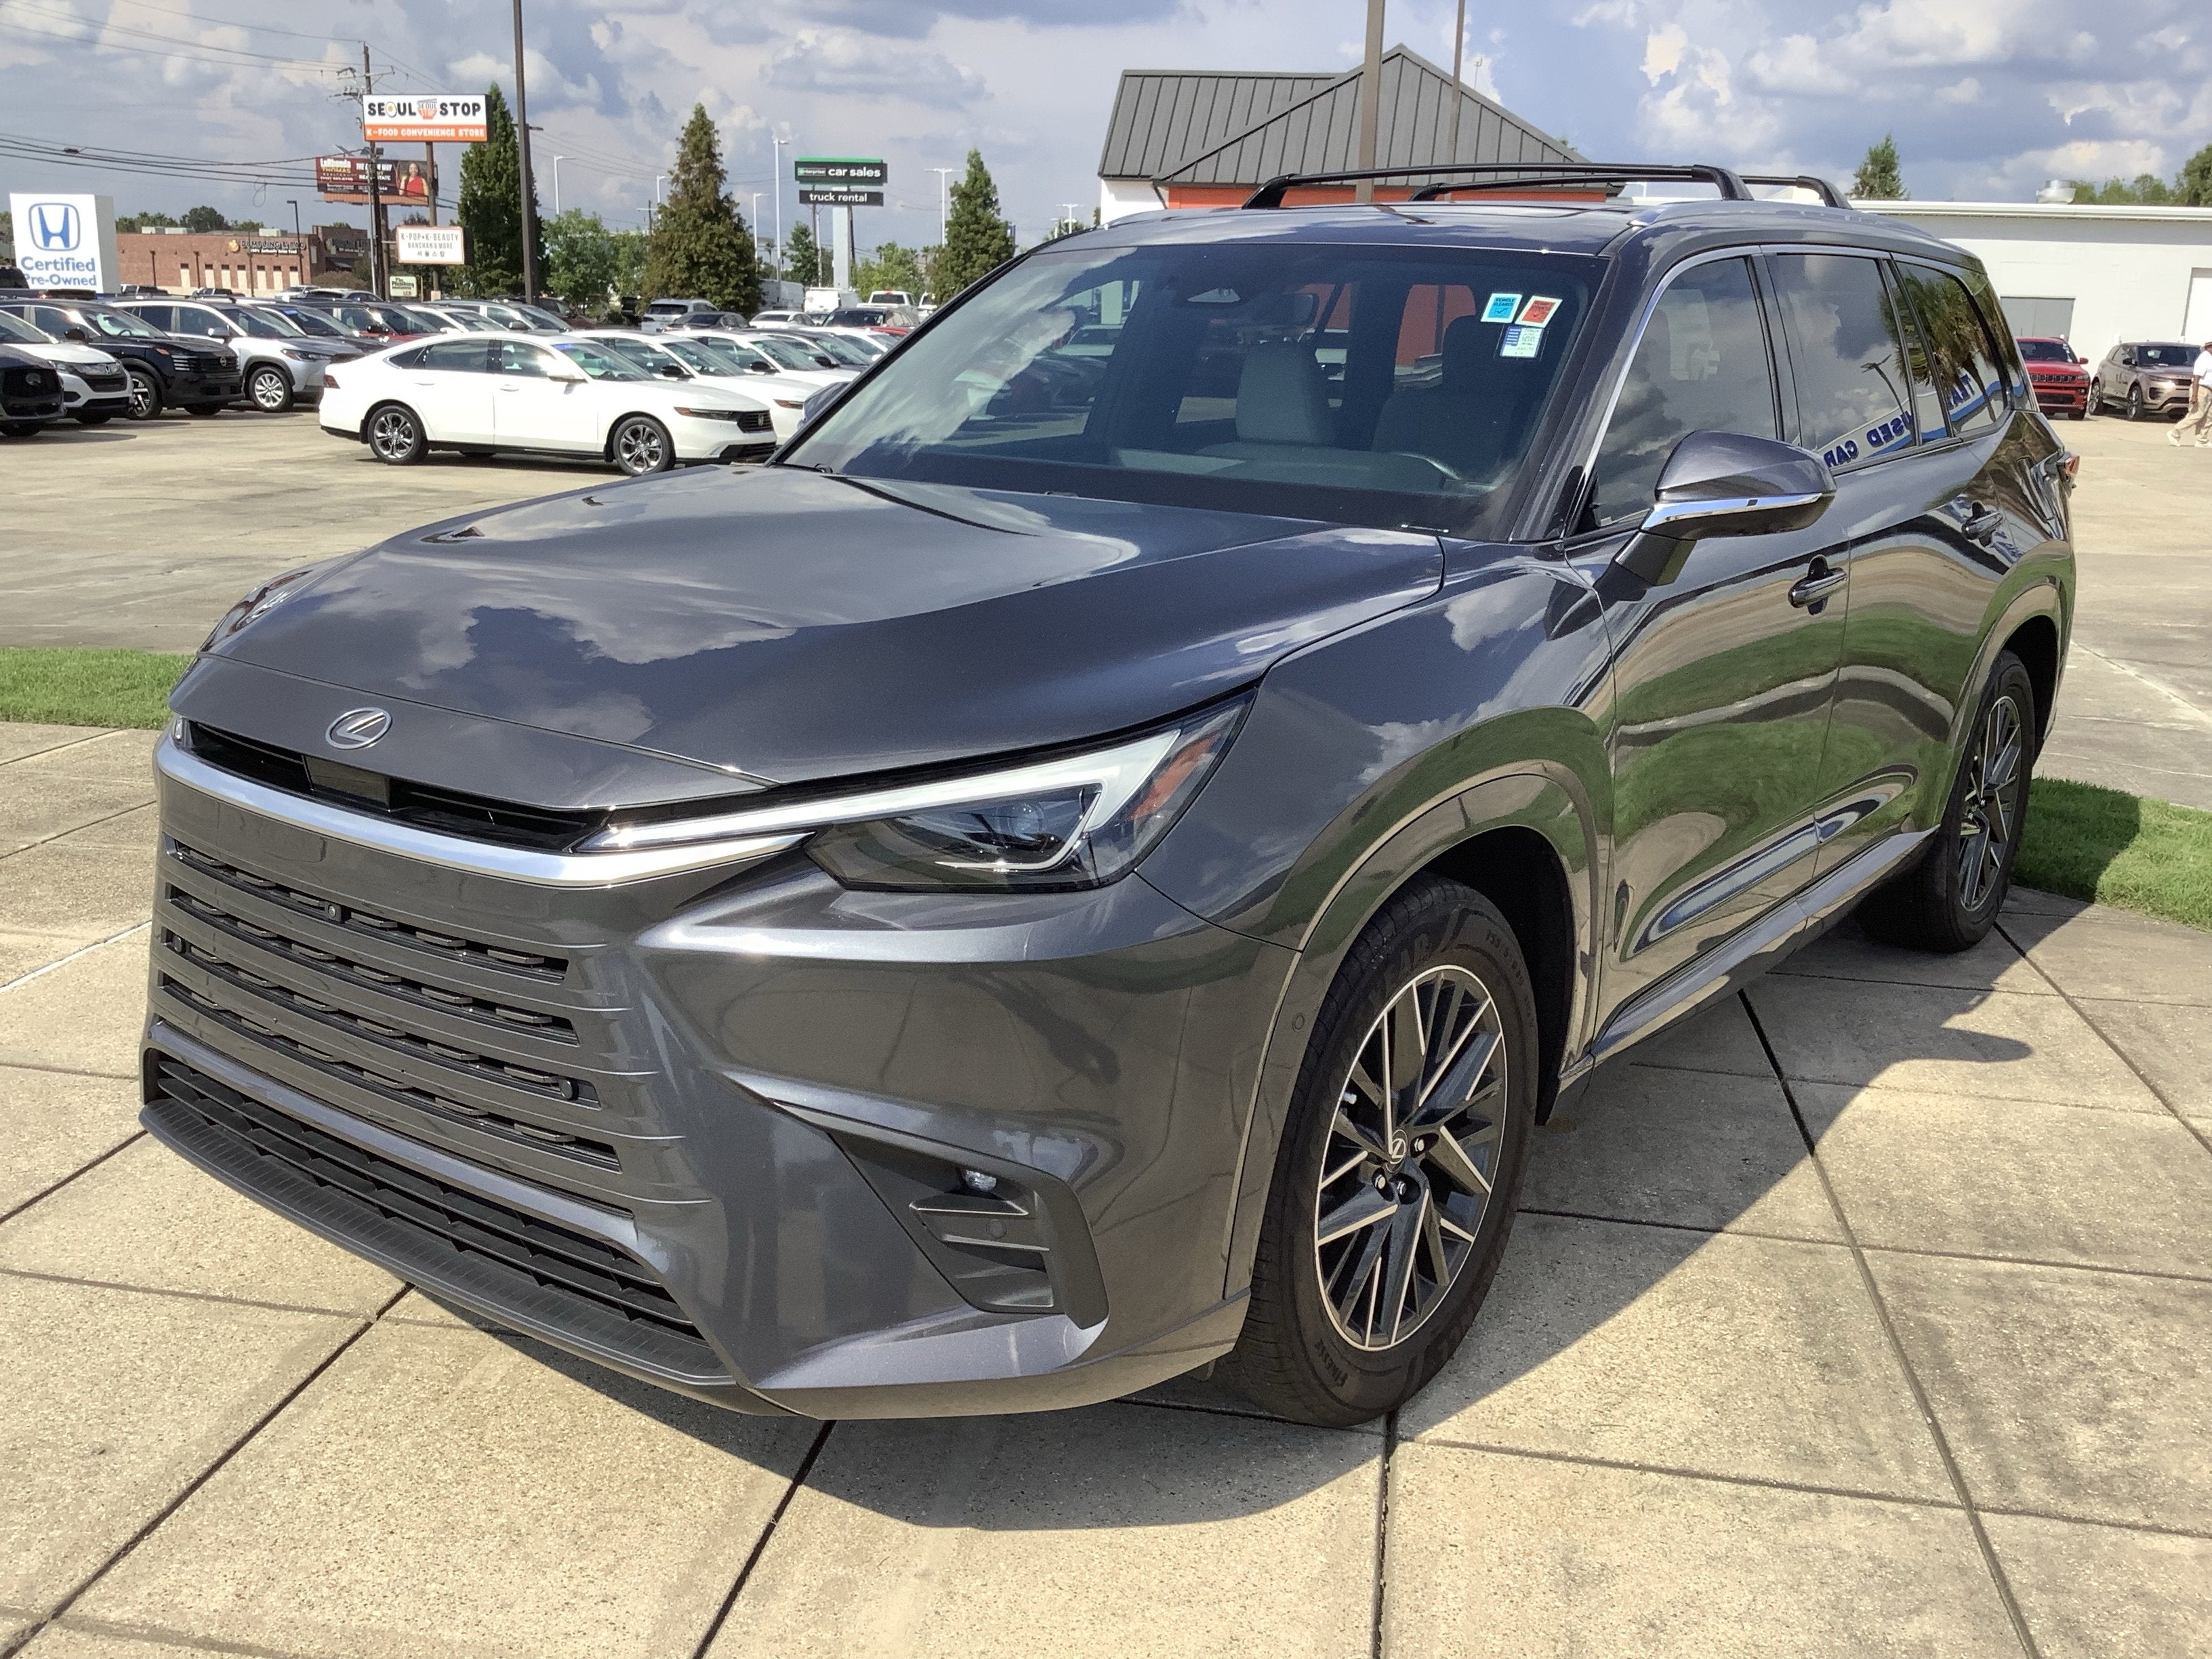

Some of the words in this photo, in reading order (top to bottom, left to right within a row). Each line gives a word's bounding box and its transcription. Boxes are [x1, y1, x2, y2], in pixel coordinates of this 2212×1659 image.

[367, 102, 416, 118] SEOUL
[439, 102, 481, 117] STOP
[366, 128, 399, 136] K-FOOD
[401, 128, 455, 136] CONVENIENCE
[458, 128, 485, 137] STORE
[828, 168, 848, 176] car
[849, 167, 881, 177] sales
[809, 192, 835, 201] truck
[838, 193, 867, 202] rental
[21, 256, 96, 272] Certified
[24, 273, 97, 286] Pre-Owned
